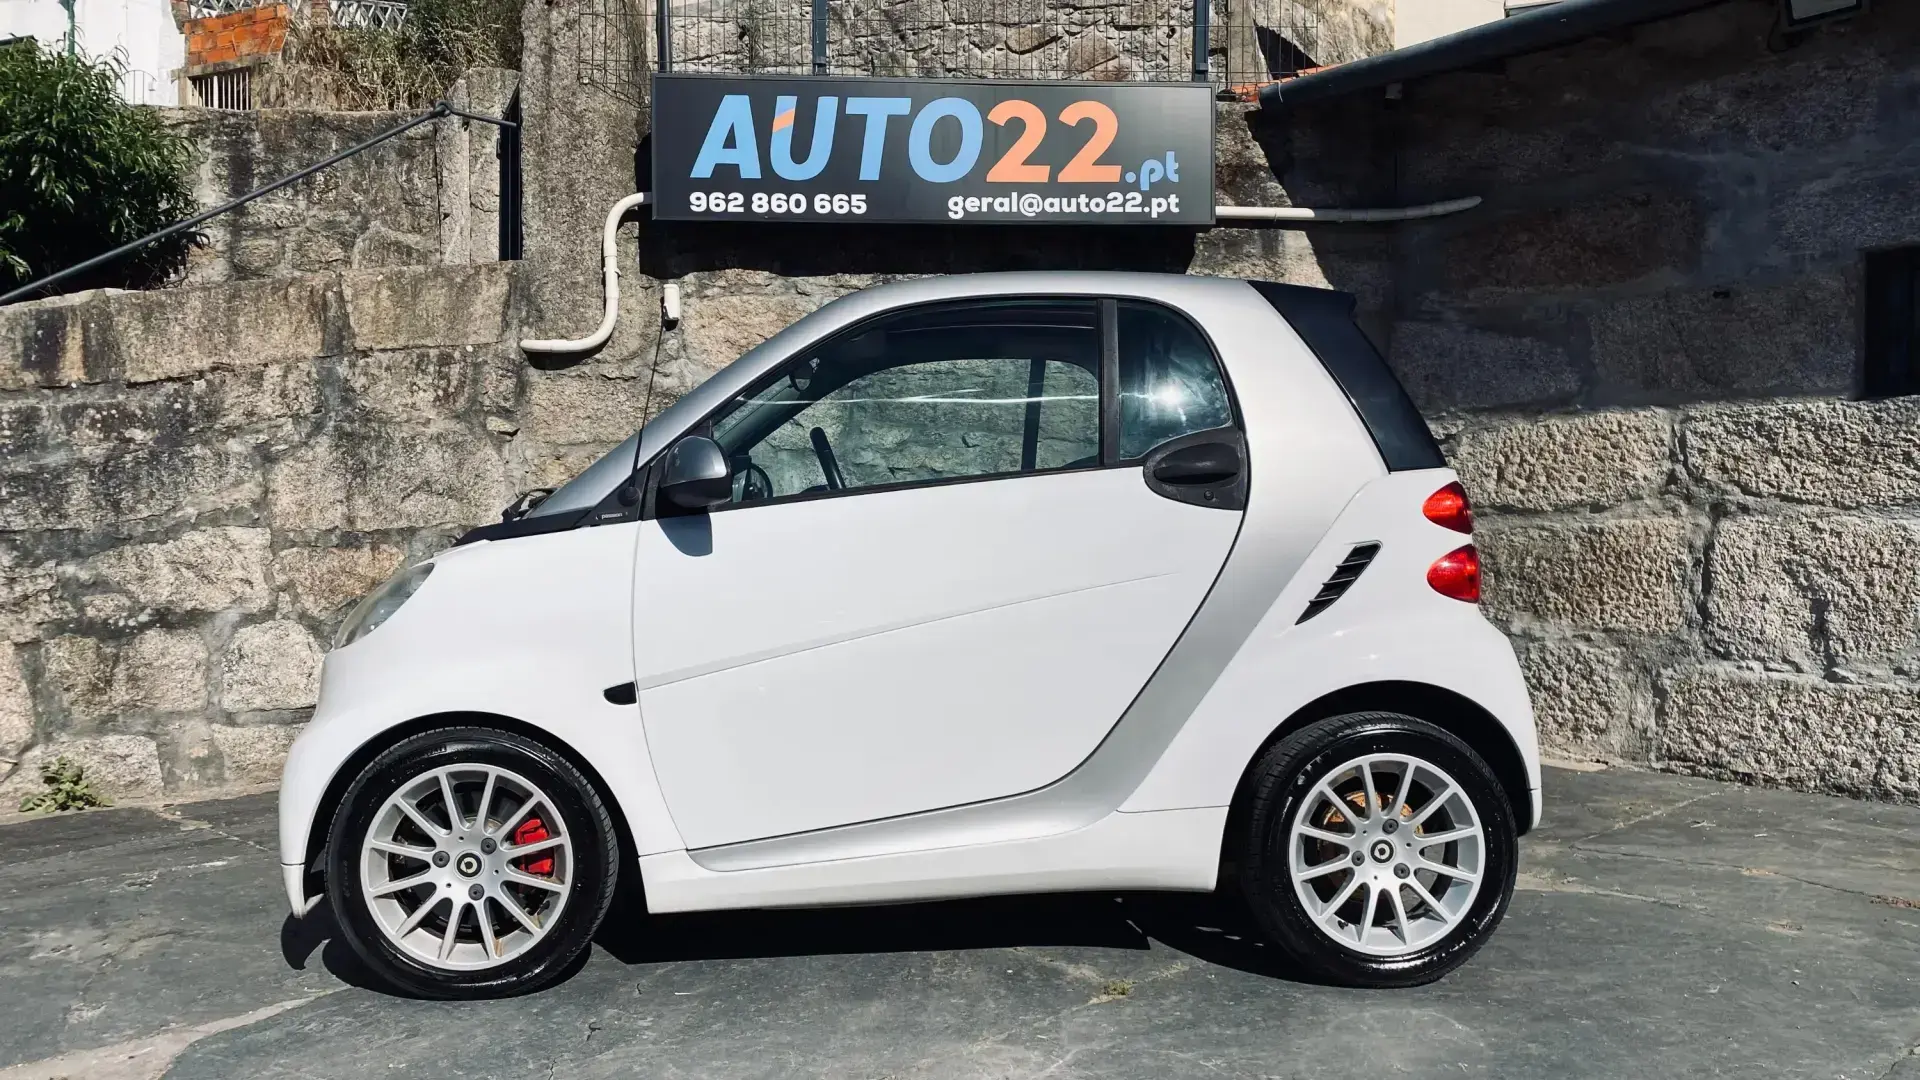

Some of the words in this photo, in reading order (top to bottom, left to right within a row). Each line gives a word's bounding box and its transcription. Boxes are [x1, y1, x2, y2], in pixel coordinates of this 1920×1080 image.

[689, 191, 745, 213] 962
[751, 192, 807, 214] 860
[813, 193, 868, 215] 665
[947, 191, 1180, 219] geral@auto22.pt
